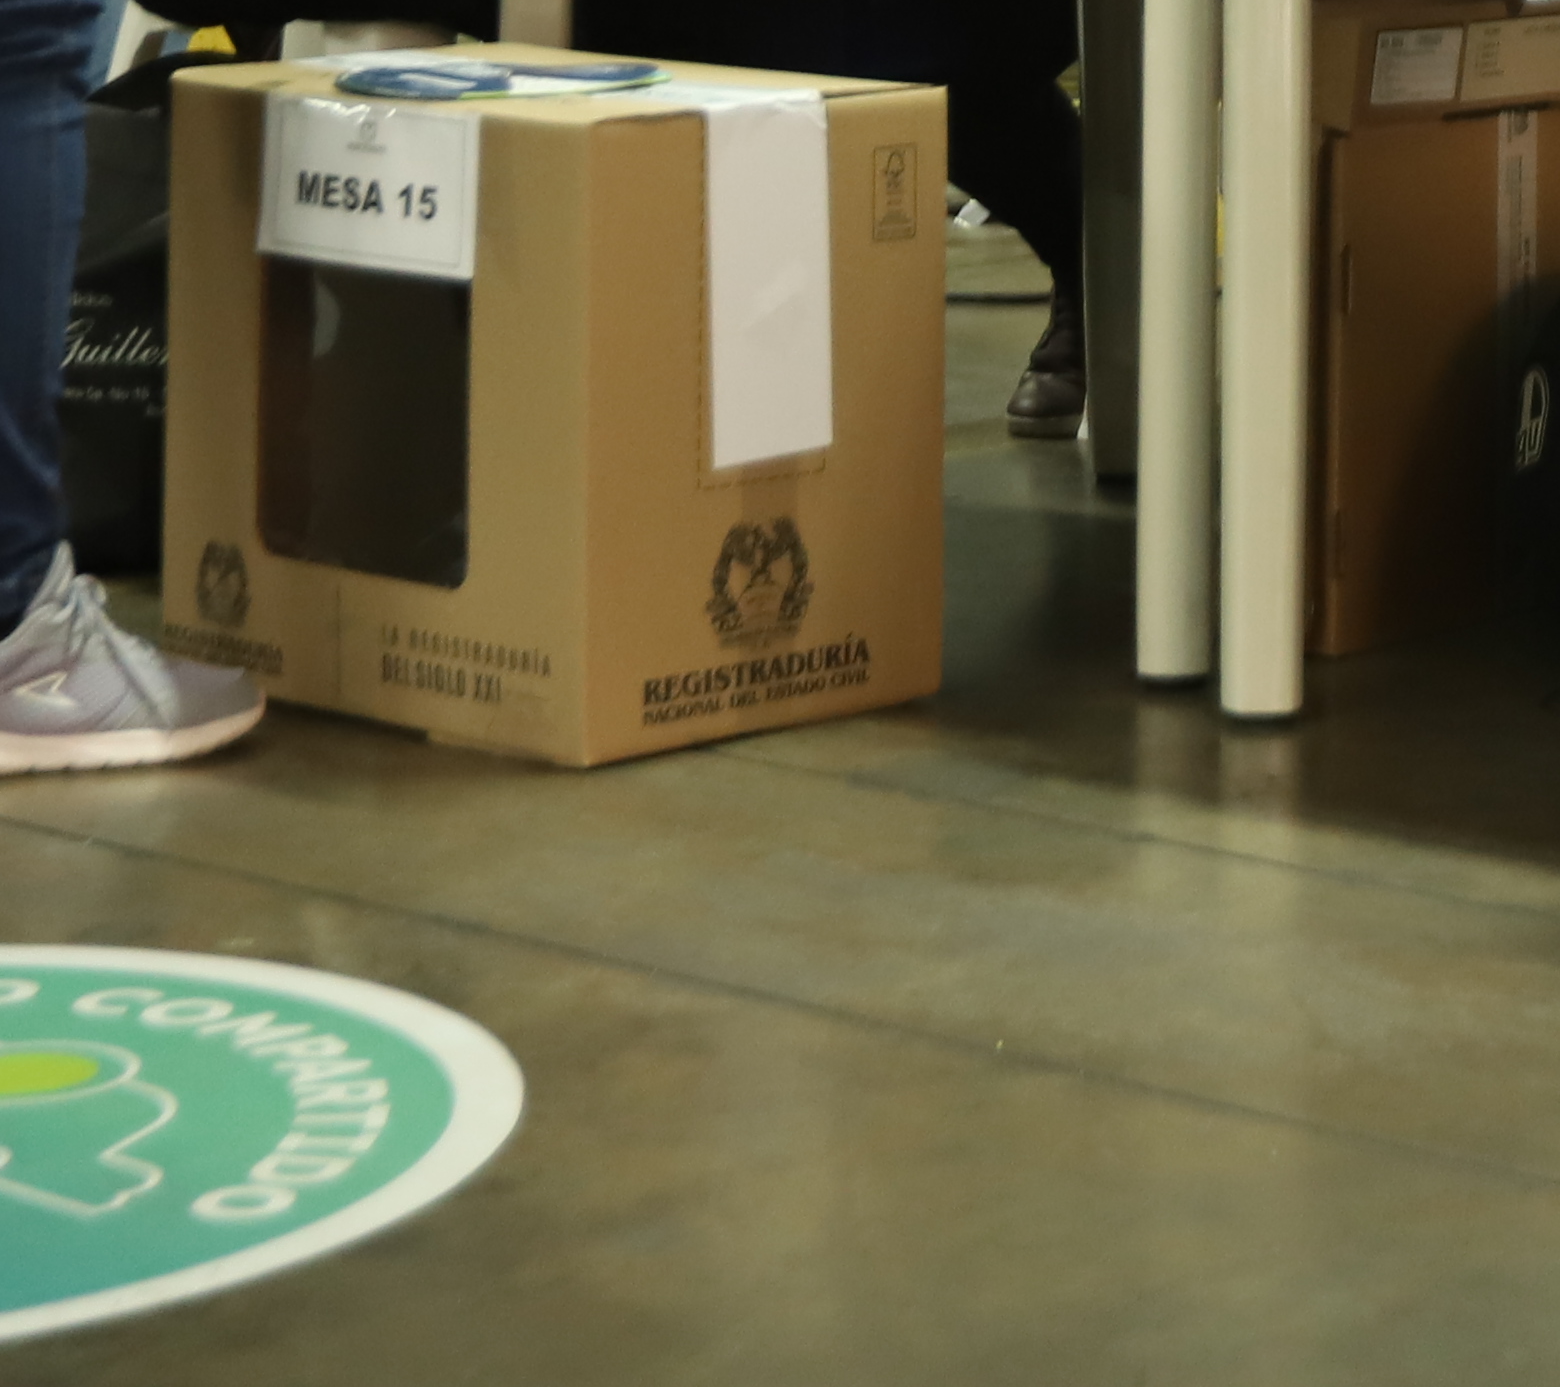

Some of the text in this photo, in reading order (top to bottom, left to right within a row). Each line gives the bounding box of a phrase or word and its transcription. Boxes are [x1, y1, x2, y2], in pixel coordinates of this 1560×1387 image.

[297, 170, 438, 220] MESA 15
[381, 651, 503, 704] DEL SIGLO XXI
[409, 626, 552, 679] REGISTRADURÍA
[643, 630, 872, 706] REGISTRADURÍA
[71, 984, 391, 1223] COMPARTIDO
